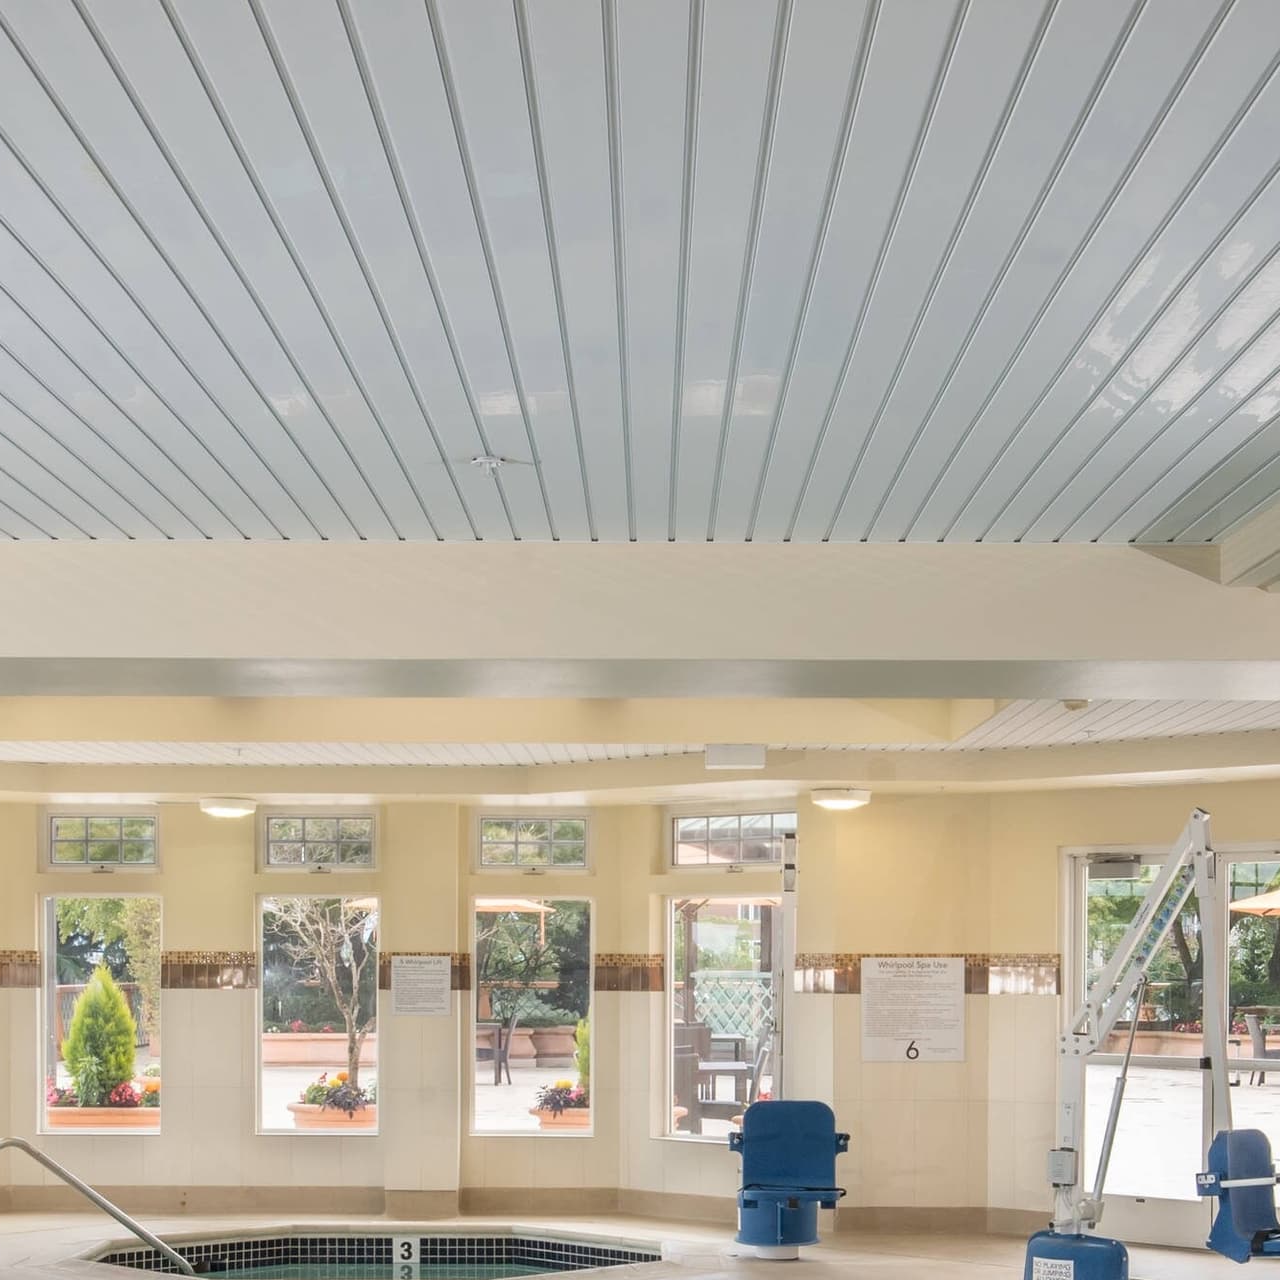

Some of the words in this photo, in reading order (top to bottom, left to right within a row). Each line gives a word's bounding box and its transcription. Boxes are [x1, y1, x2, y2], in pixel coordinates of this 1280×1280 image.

[878, 960, 914, 970] Whirlpool
[916, 960, 931, 970] Spa
[933, 961, 948, 969] Use
[906, 1040, 919, 1060] 6
[400, 1241, 413, 1260] 3
[1043, 1262, 1071, 1271] PLAYING
[1041, 1269, 1071, 1279] JUMPING
